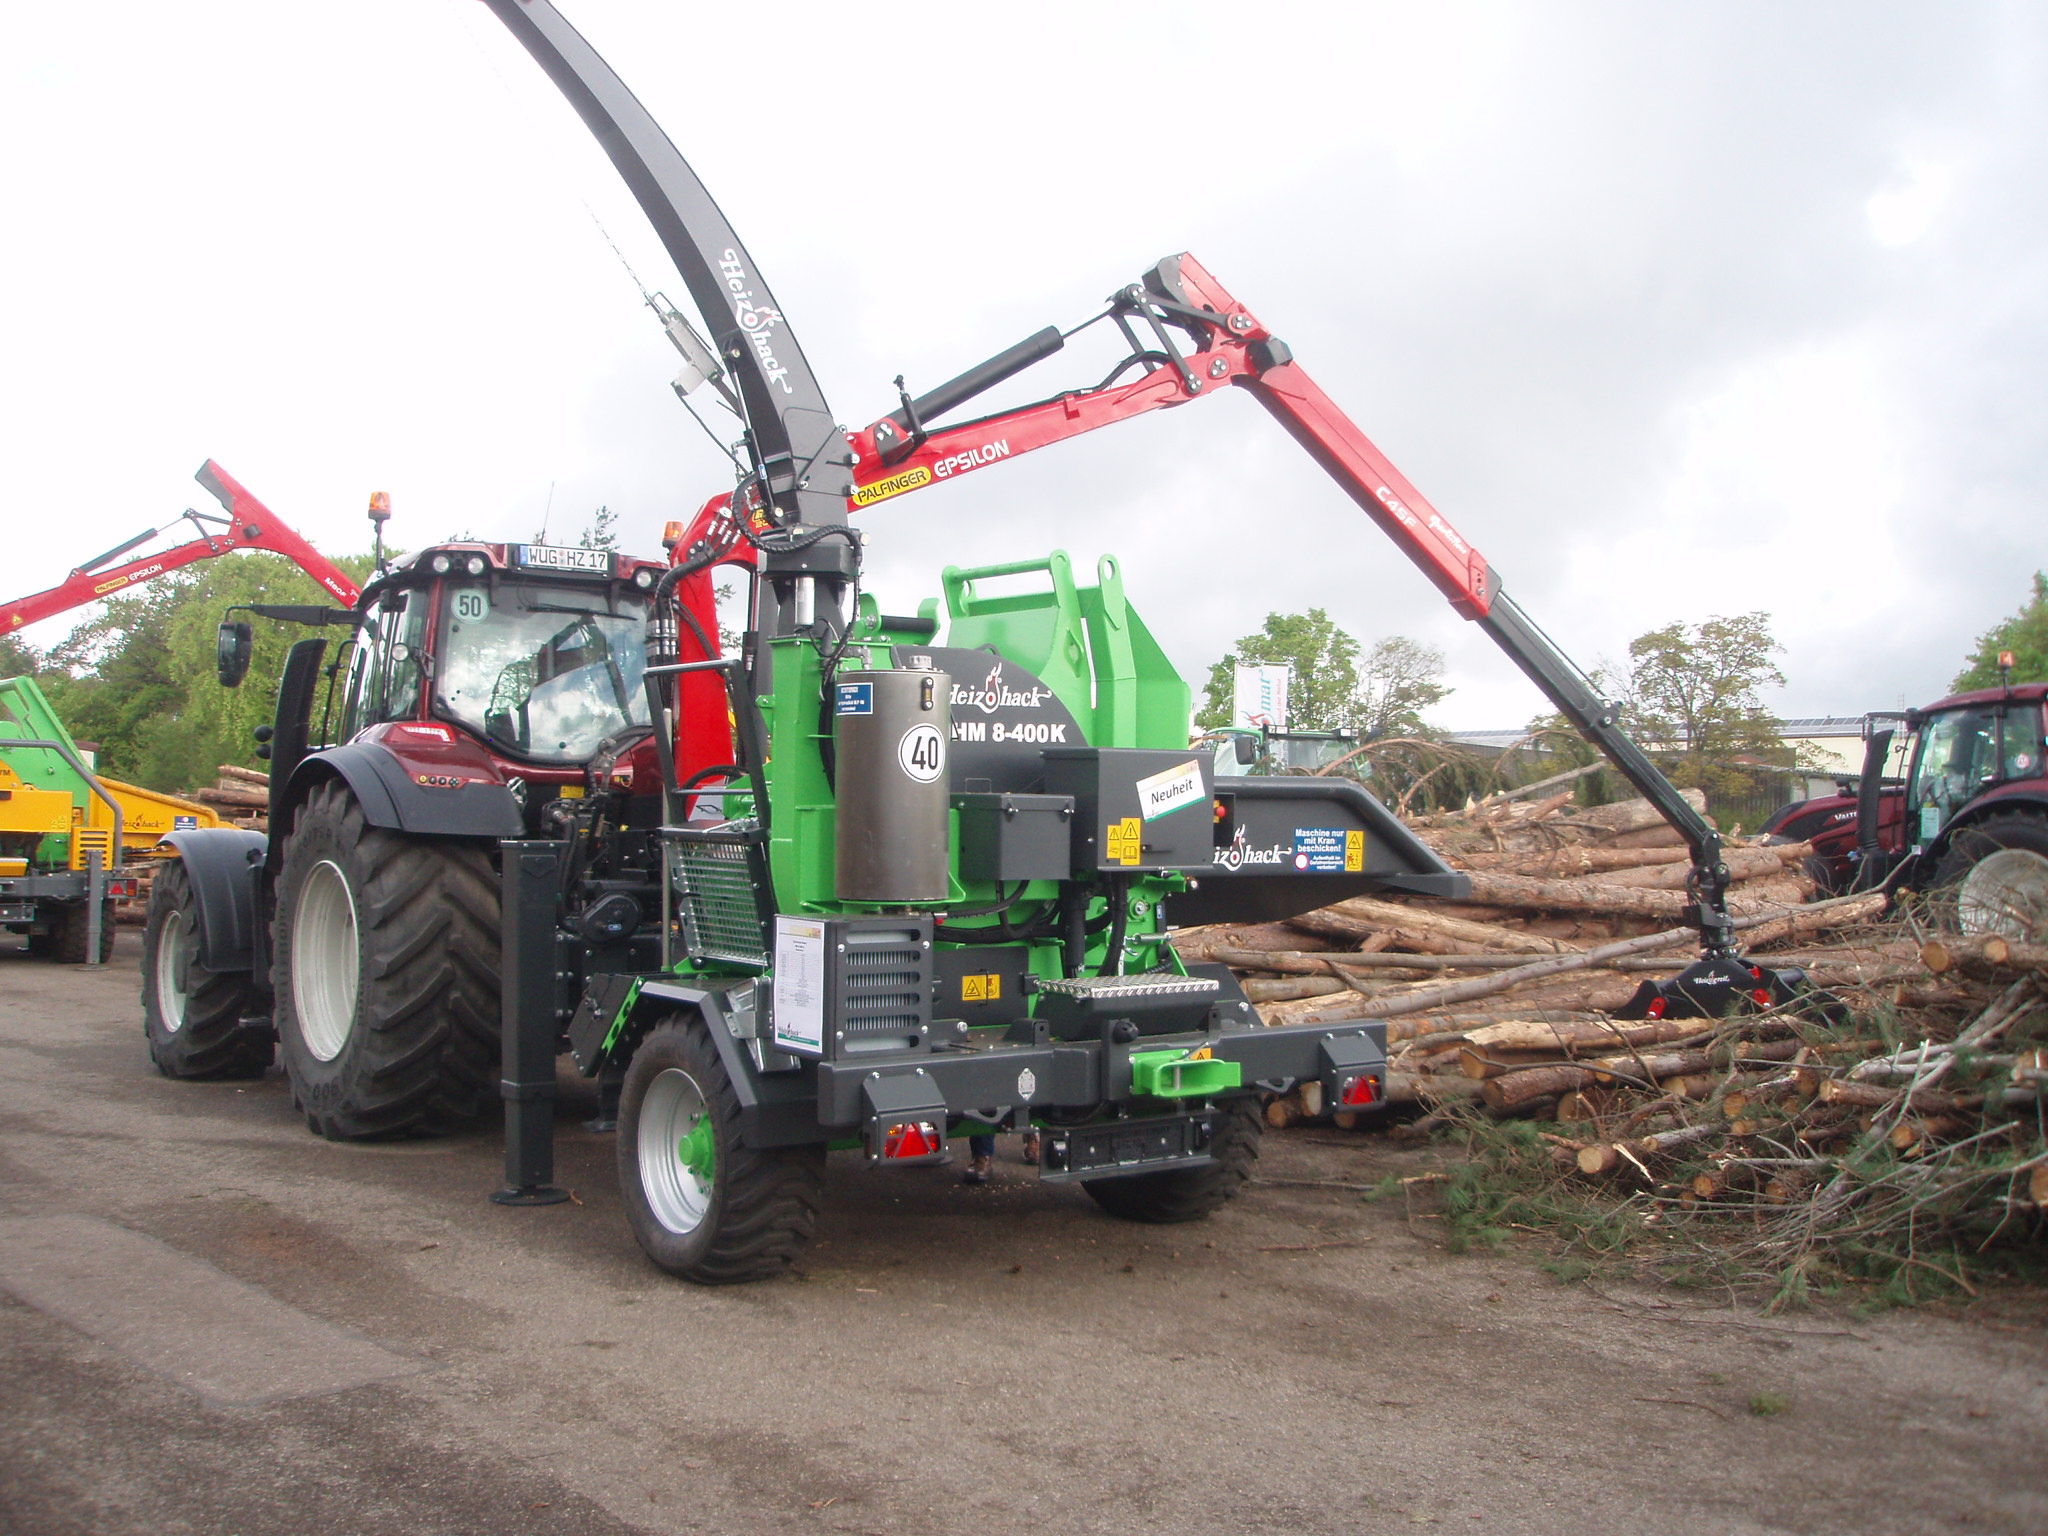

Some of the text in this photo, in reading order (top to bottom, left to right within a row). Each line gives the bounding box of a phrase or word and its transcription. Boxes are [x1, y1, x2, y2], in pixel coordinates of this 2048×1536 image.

[857, 439, 1010, 503] PALFINGER EPSILON
[529, 548, 606, 570] WUG HZ 17
[129, 563, 163, 580] EPSILON
[459, 595, 481, 617] 50
[992, 723, 1066, 743] 8-400K
[911, 736, 938, 770] 40
[1151, 779, 1193, 805] Neuheit
[1295, 829, 1330, 837] Maschine
[1317, 836, 1335, 844] Kran
[1213, 824, 1292, 871] izohack
[1297, 844, 1341, 852] beschicken!
